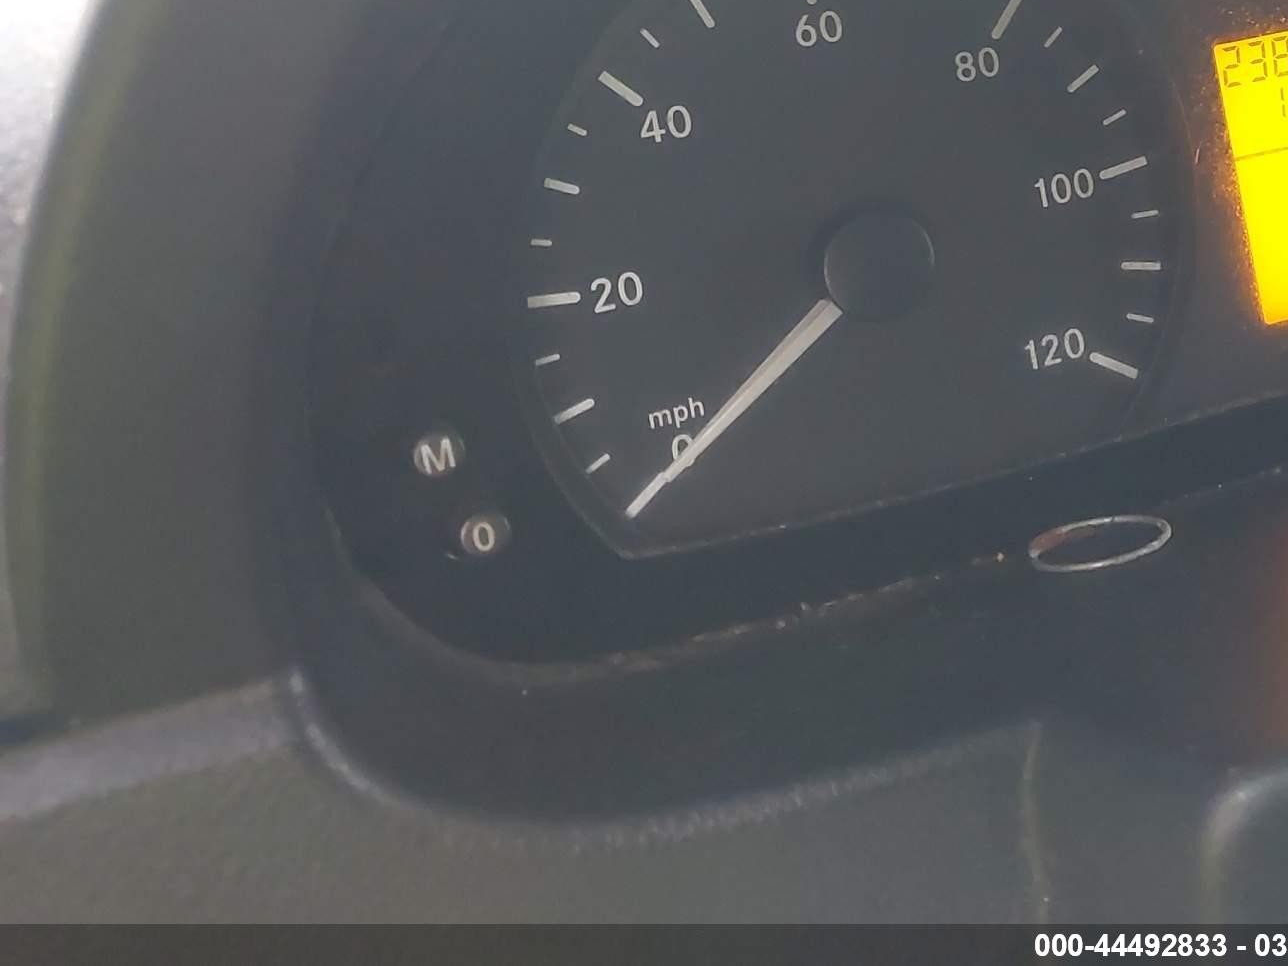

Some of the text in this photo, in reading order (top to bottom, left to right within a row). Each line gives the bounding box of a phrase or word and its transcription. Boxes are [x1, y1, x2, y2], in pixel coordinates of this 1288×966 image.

[794, 10, 843, 47] 60
[954, 47, 1000, 82] 80
[639, 104, 693, 143] 40
[1033, 168, 1095, 208] 100
[590, 271, 643, 314] 20
[1023, 327, 1086, 370] 120
[648, 397, 706, 430] mph
[420, 437, 456, 474] M
